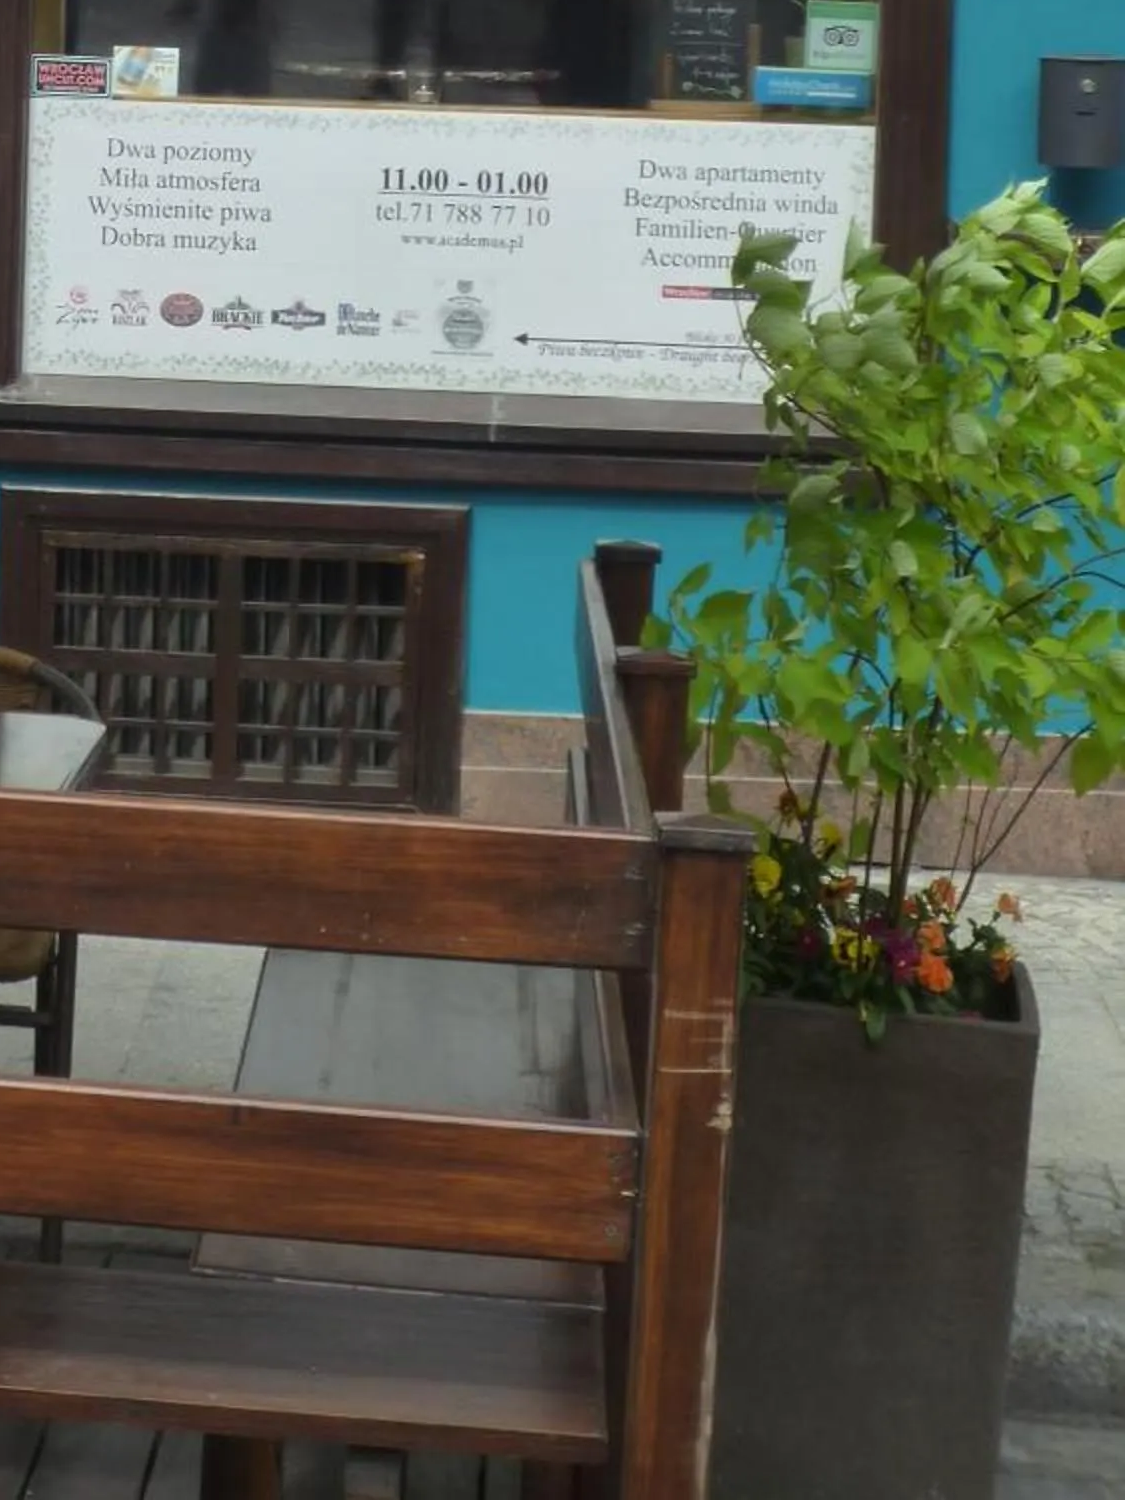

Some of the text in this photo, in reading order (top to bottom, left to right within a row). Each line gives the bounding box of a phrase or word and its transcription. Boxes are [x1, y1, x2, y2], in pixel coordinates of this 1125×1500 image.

[107, 137, 256, 168] Dwa poziomy
[99, 167, 262, 193] Miła atmosfera
[381, 167, 449, 191] 11.00
[476, 170, 550, 196] 01.00
[638, 159, 826, 190] Dwa apartamenty
[87, 195, 273, 227] Wyśmienite piwa
[443, 203, 483, 225] 788
[491, 204, 517, 226] 77
[526, 206, 551, 227] 10
[623, 187, 840, 215] Bezpośrednia winda
[101, 225, 258, 255] Dobra muzyka
